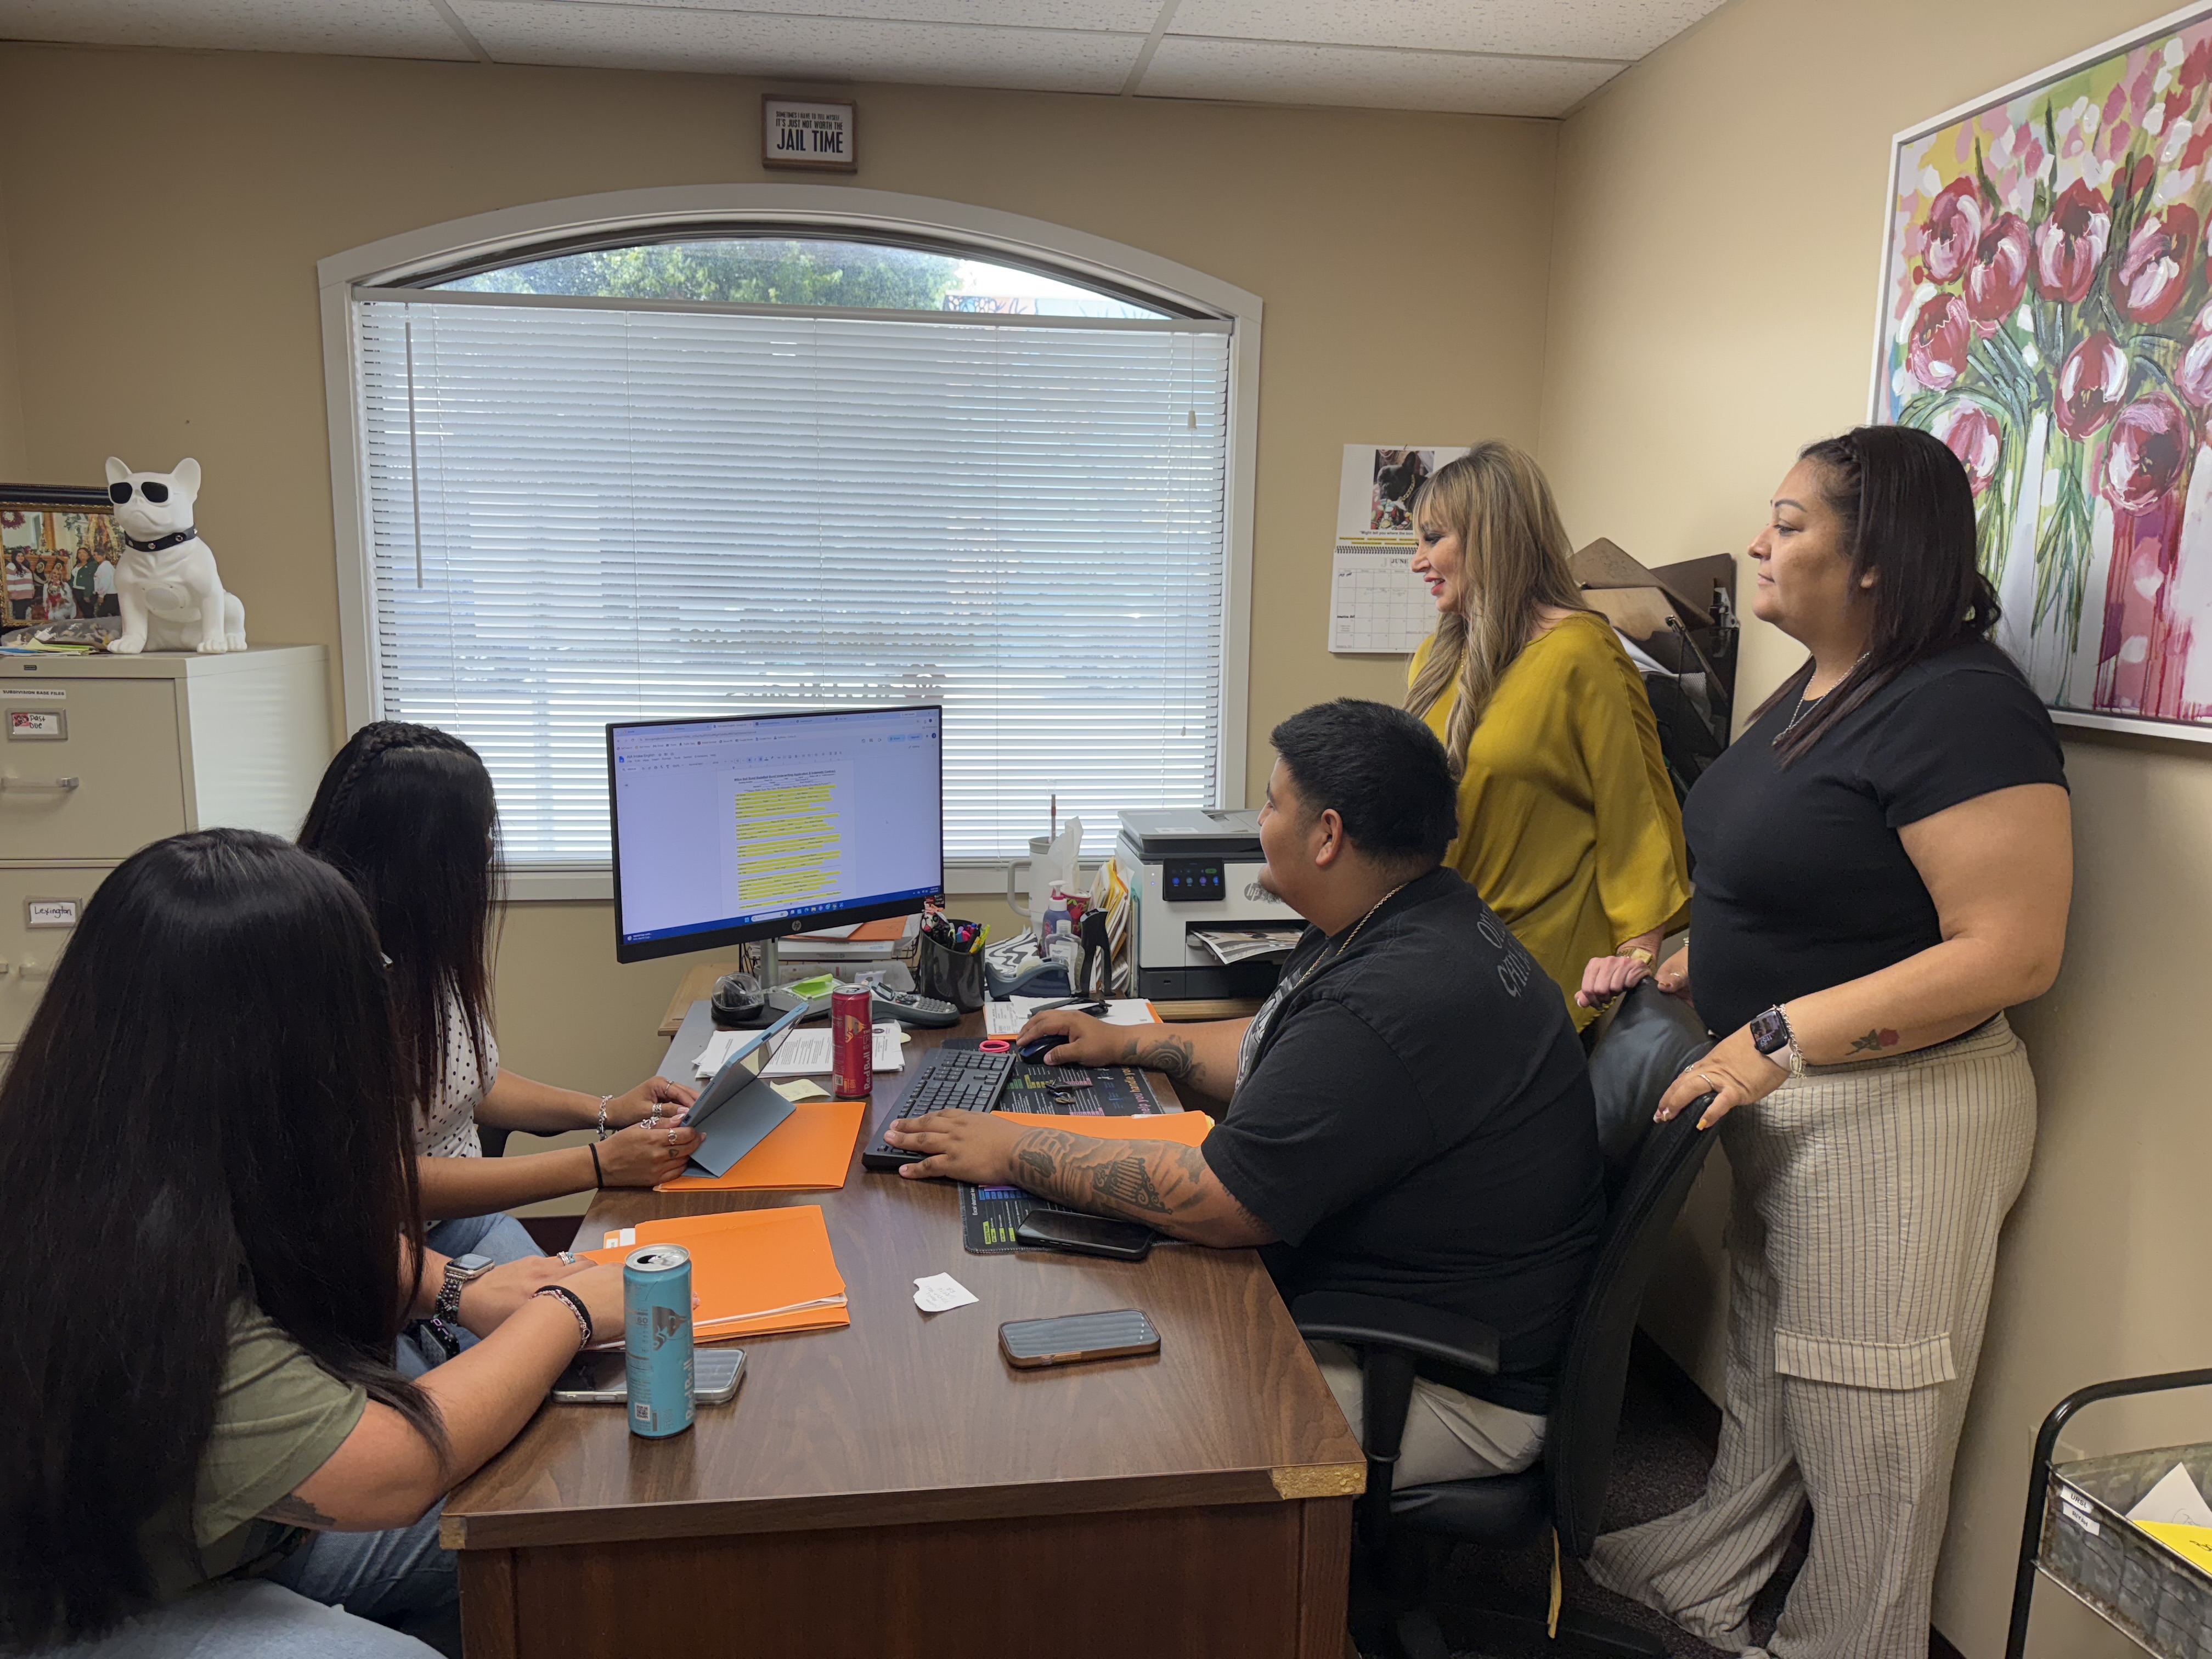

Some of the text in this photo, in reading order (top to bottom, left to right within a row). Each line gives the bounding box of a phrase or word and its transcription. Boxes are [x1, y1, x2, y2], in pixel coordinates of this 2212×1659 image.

[788, 120, 800, 128] JUST
[814, 121, 832, 129] WORTH
[834, 122, 843, 130] THE
[777, 128, 843, 153] JAIL TIME
[33, 905, 72, 919] Lexington
[863, 1070, 871, 1091] Red
[1124, 1076, 1141, 1093] handle
[1134, 1093, 1149, 1103] you
